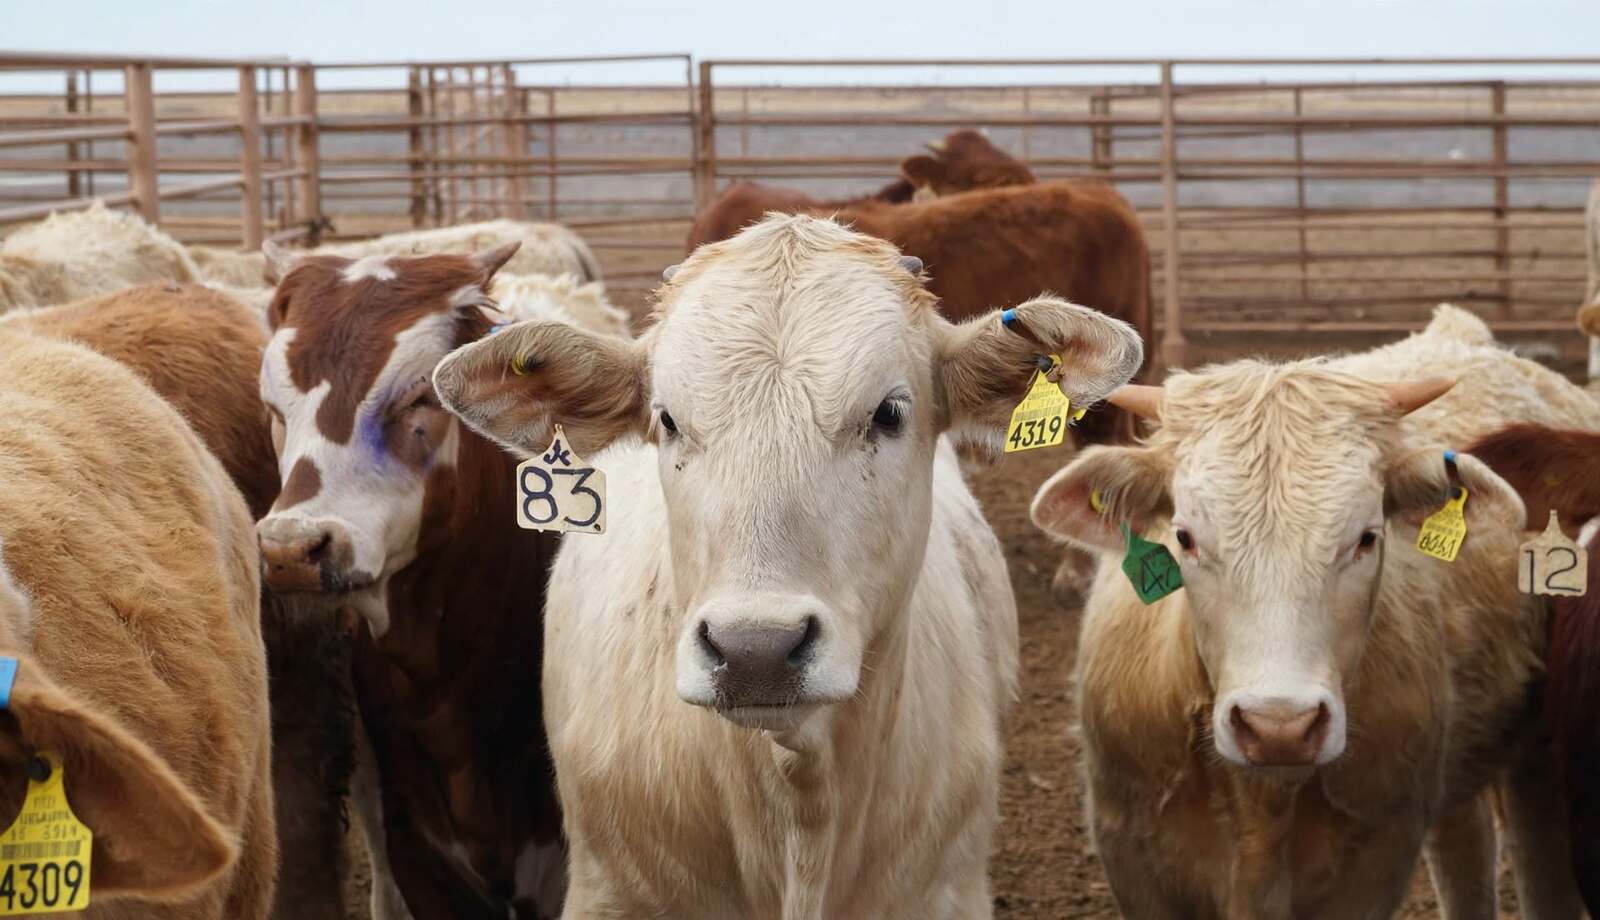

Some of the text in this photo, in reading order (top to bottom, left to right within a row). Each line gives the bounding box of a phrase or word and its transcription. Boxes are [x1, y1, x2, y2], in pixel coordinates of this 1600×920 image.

[1009, 416, 1062, 449] 4319
[520, 466, 601, 526] 83
[1525, 547, 1582, 595] 12
[0, 860, 83, 910] 4309
